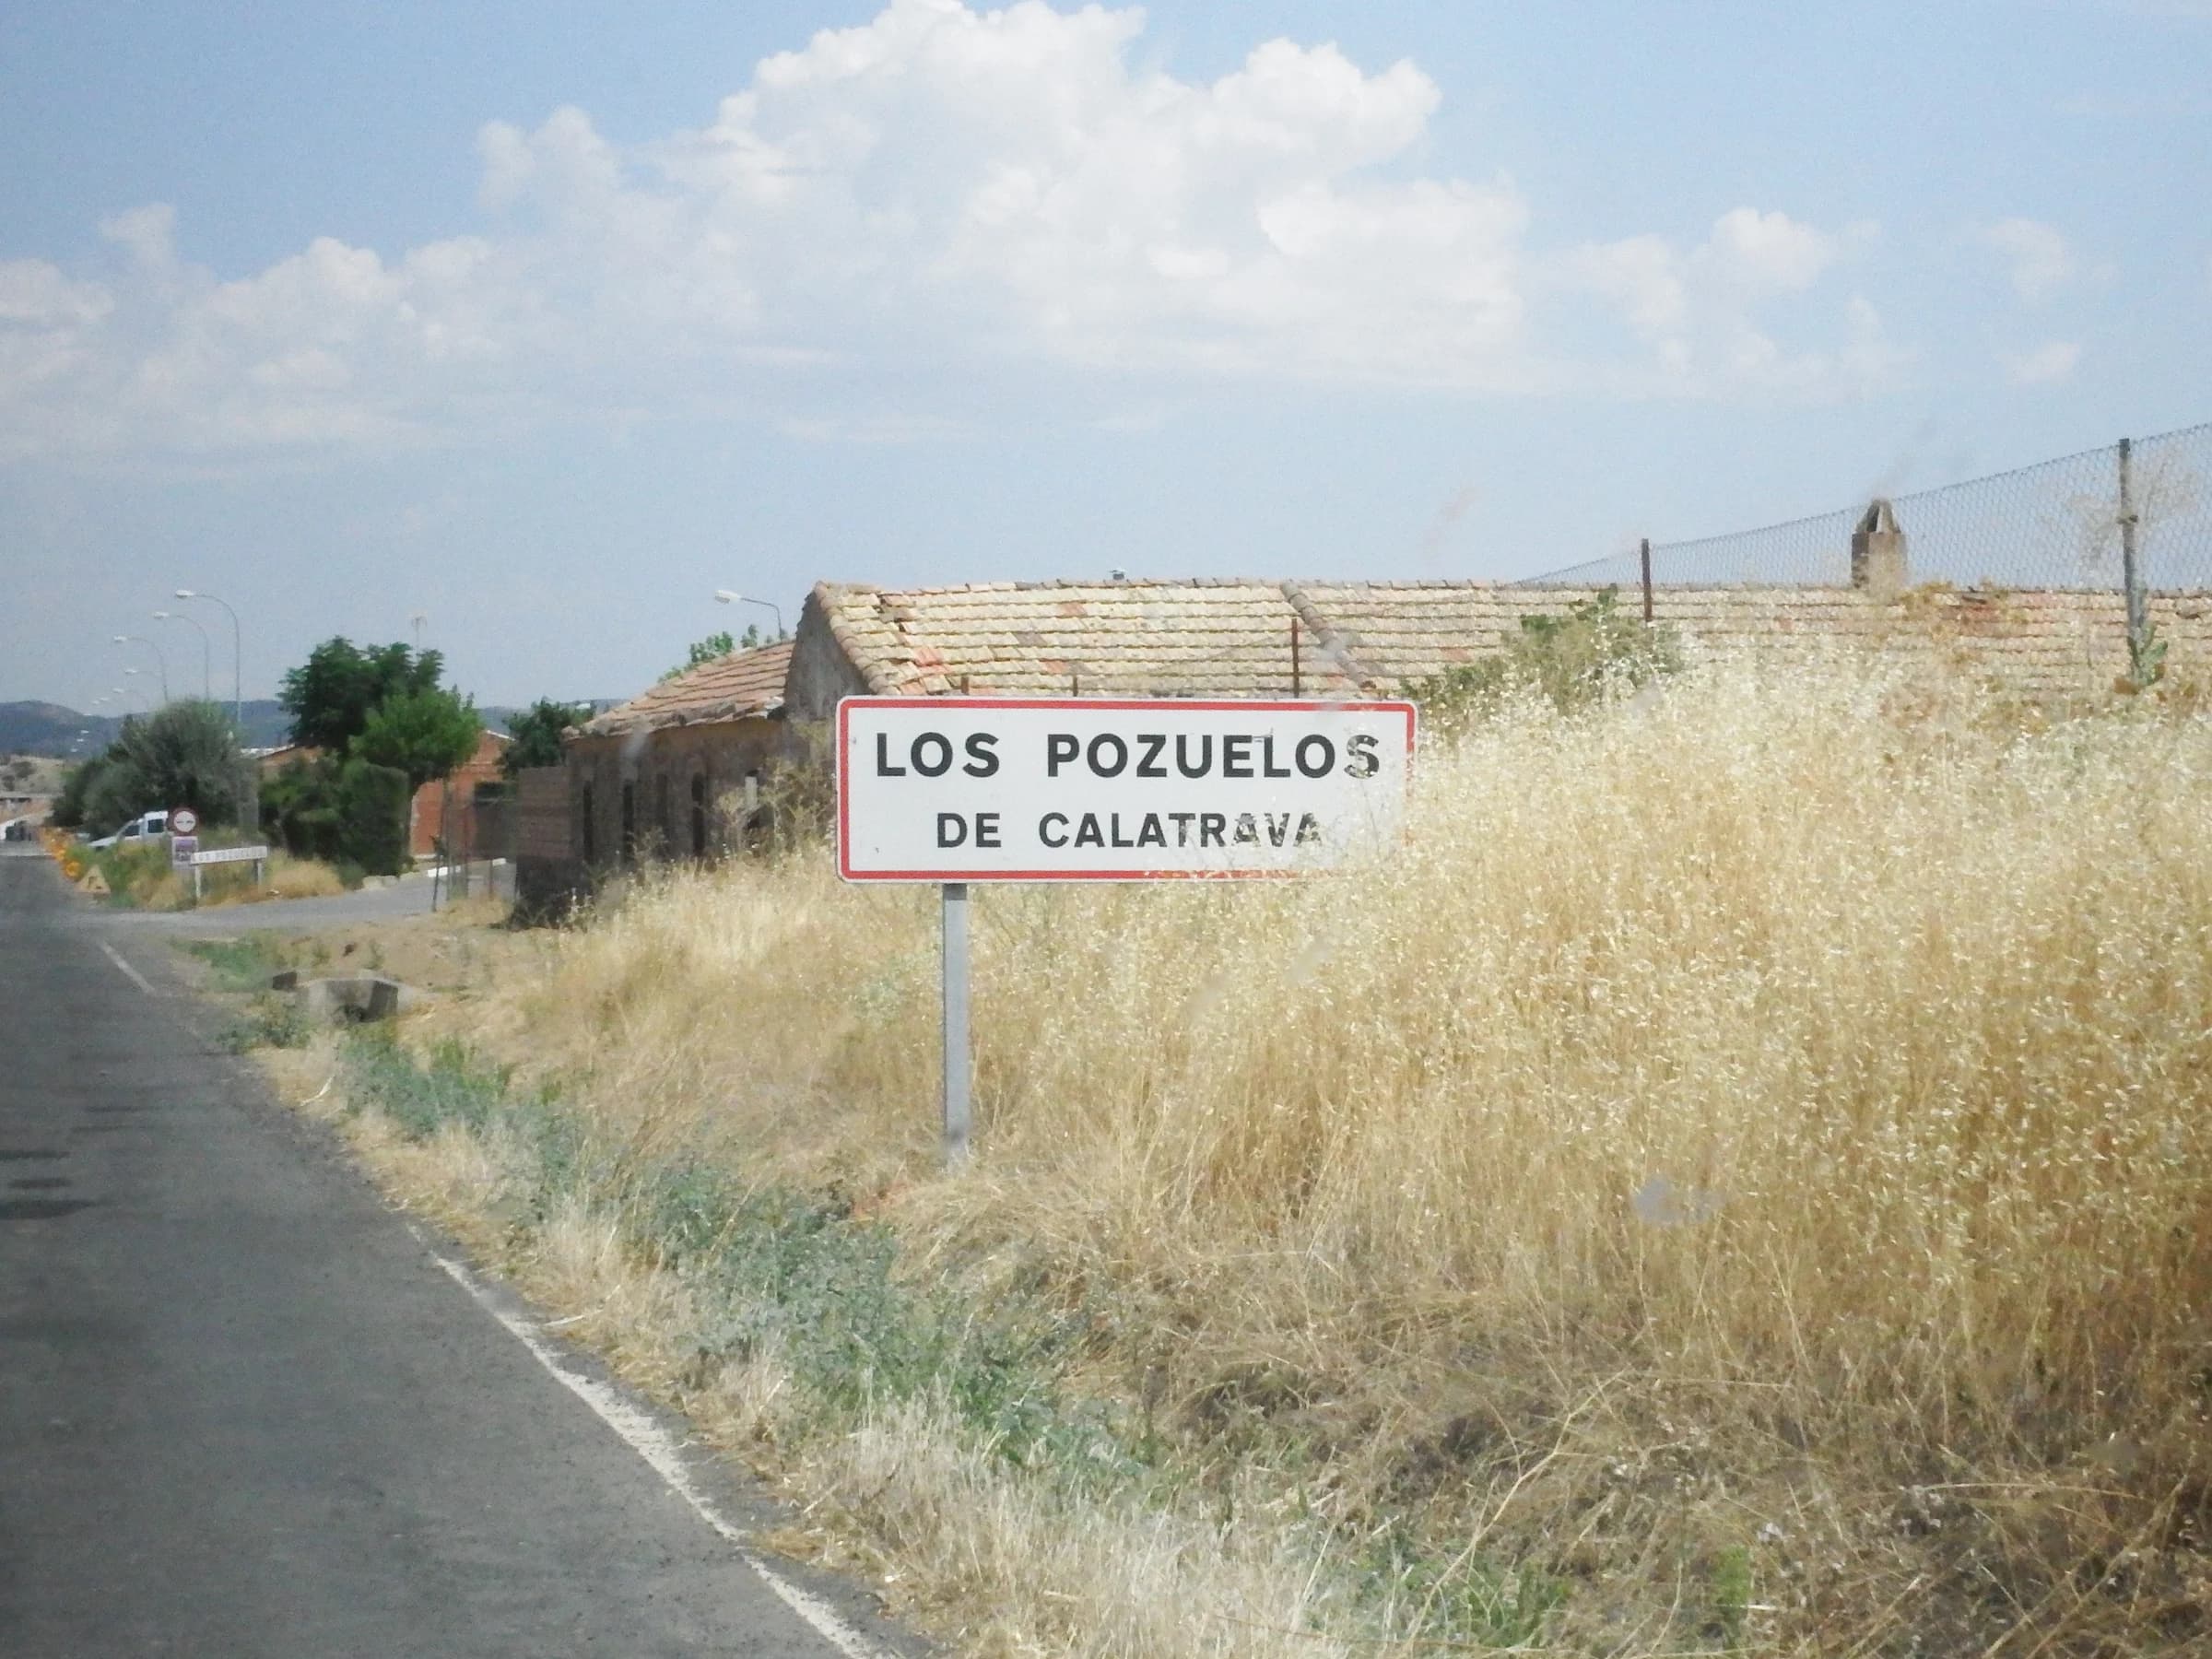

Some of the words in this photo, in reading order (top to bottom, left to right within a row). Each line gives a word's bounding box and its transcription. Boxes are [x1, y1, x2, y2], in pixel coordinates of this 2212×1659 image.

[877, 732, 1000, 777] LOS
[1047, 734, 1380, 778] POZUELOS
[936, 813, 1002, 848] DE
[1040, 812, 1322, 848] CALATRAVA
